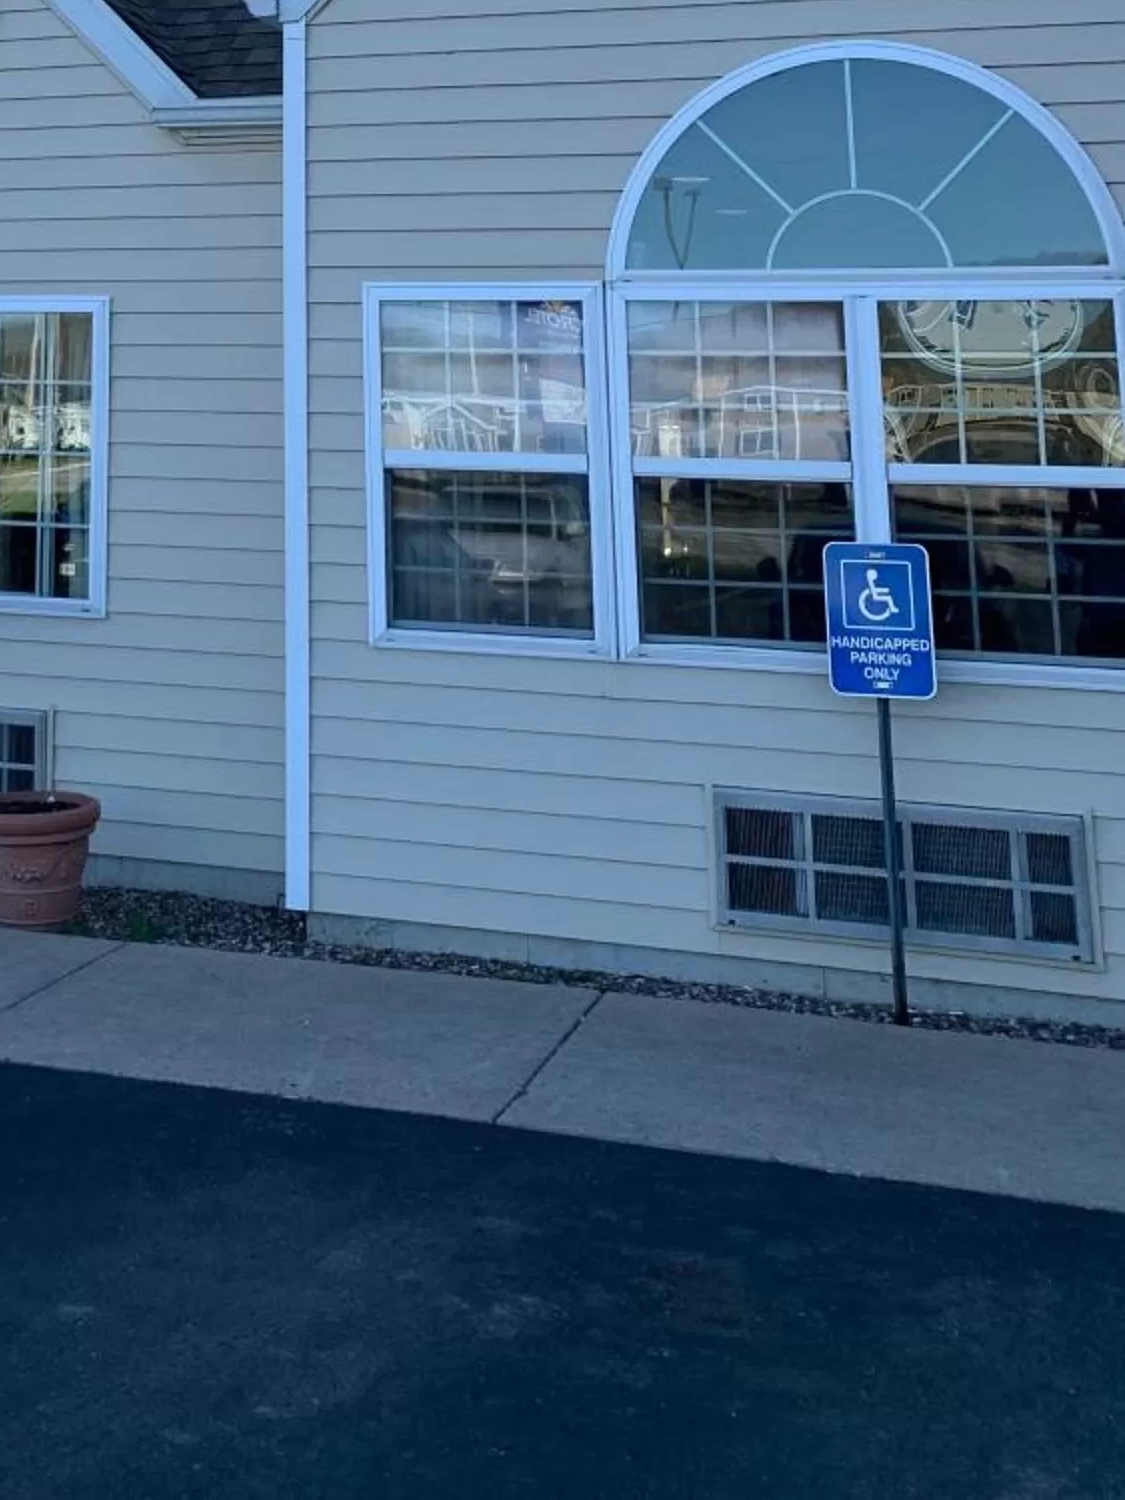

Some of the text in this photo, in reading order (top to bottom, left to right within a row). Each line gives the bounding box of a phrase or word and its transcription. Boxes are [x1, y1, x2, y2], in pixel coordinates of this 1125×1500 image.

[831, 635, 930, 652] HANDICAPPED
[850, 651, 912, 667] PARKING
[864, 667, 900, 681] ONLY
